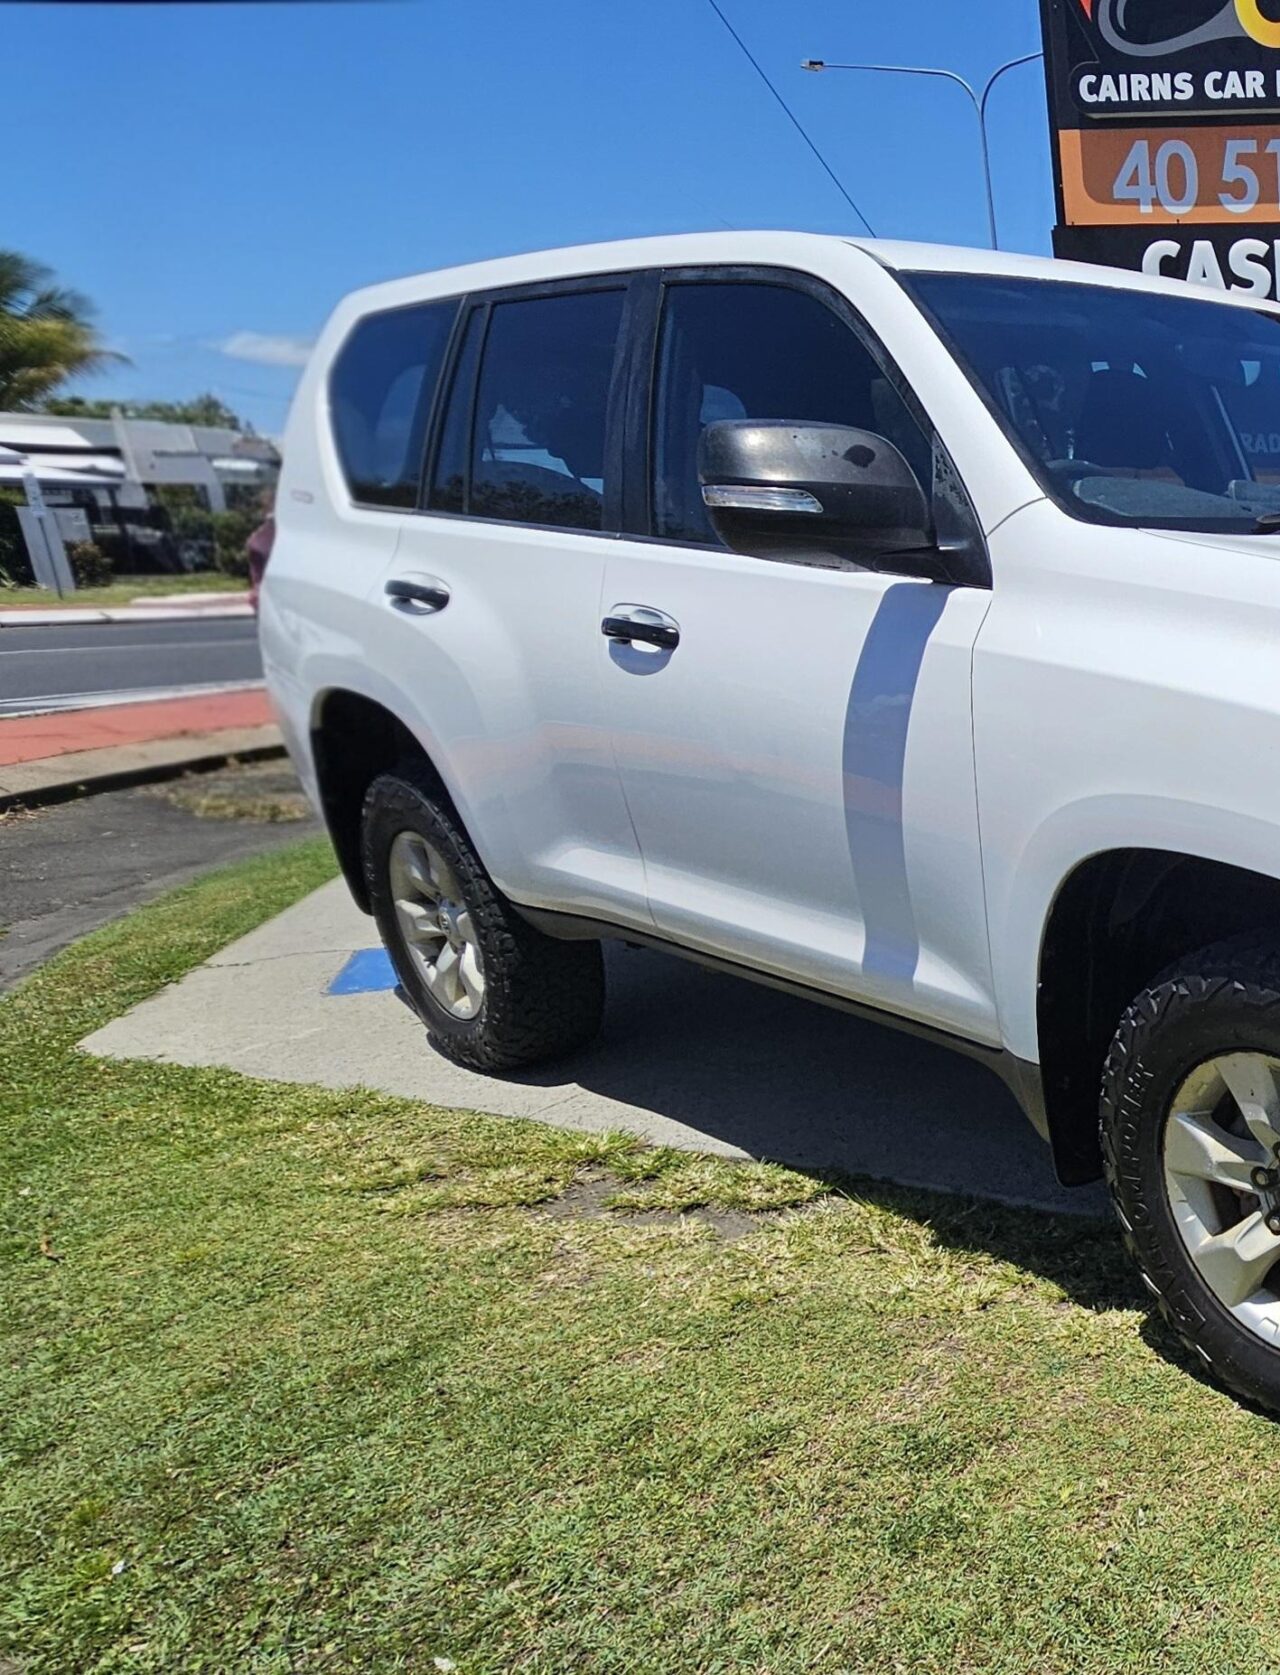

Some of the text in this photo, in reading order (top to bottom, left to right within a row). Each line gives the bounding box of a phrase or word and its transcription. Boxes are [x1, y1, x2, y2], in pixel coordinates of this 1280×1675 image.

[1079, 72, 1194, 103] CAIRNS
[1204, 71, 1266, 99] CAR
[1112, 139, 1198, 214] 40
